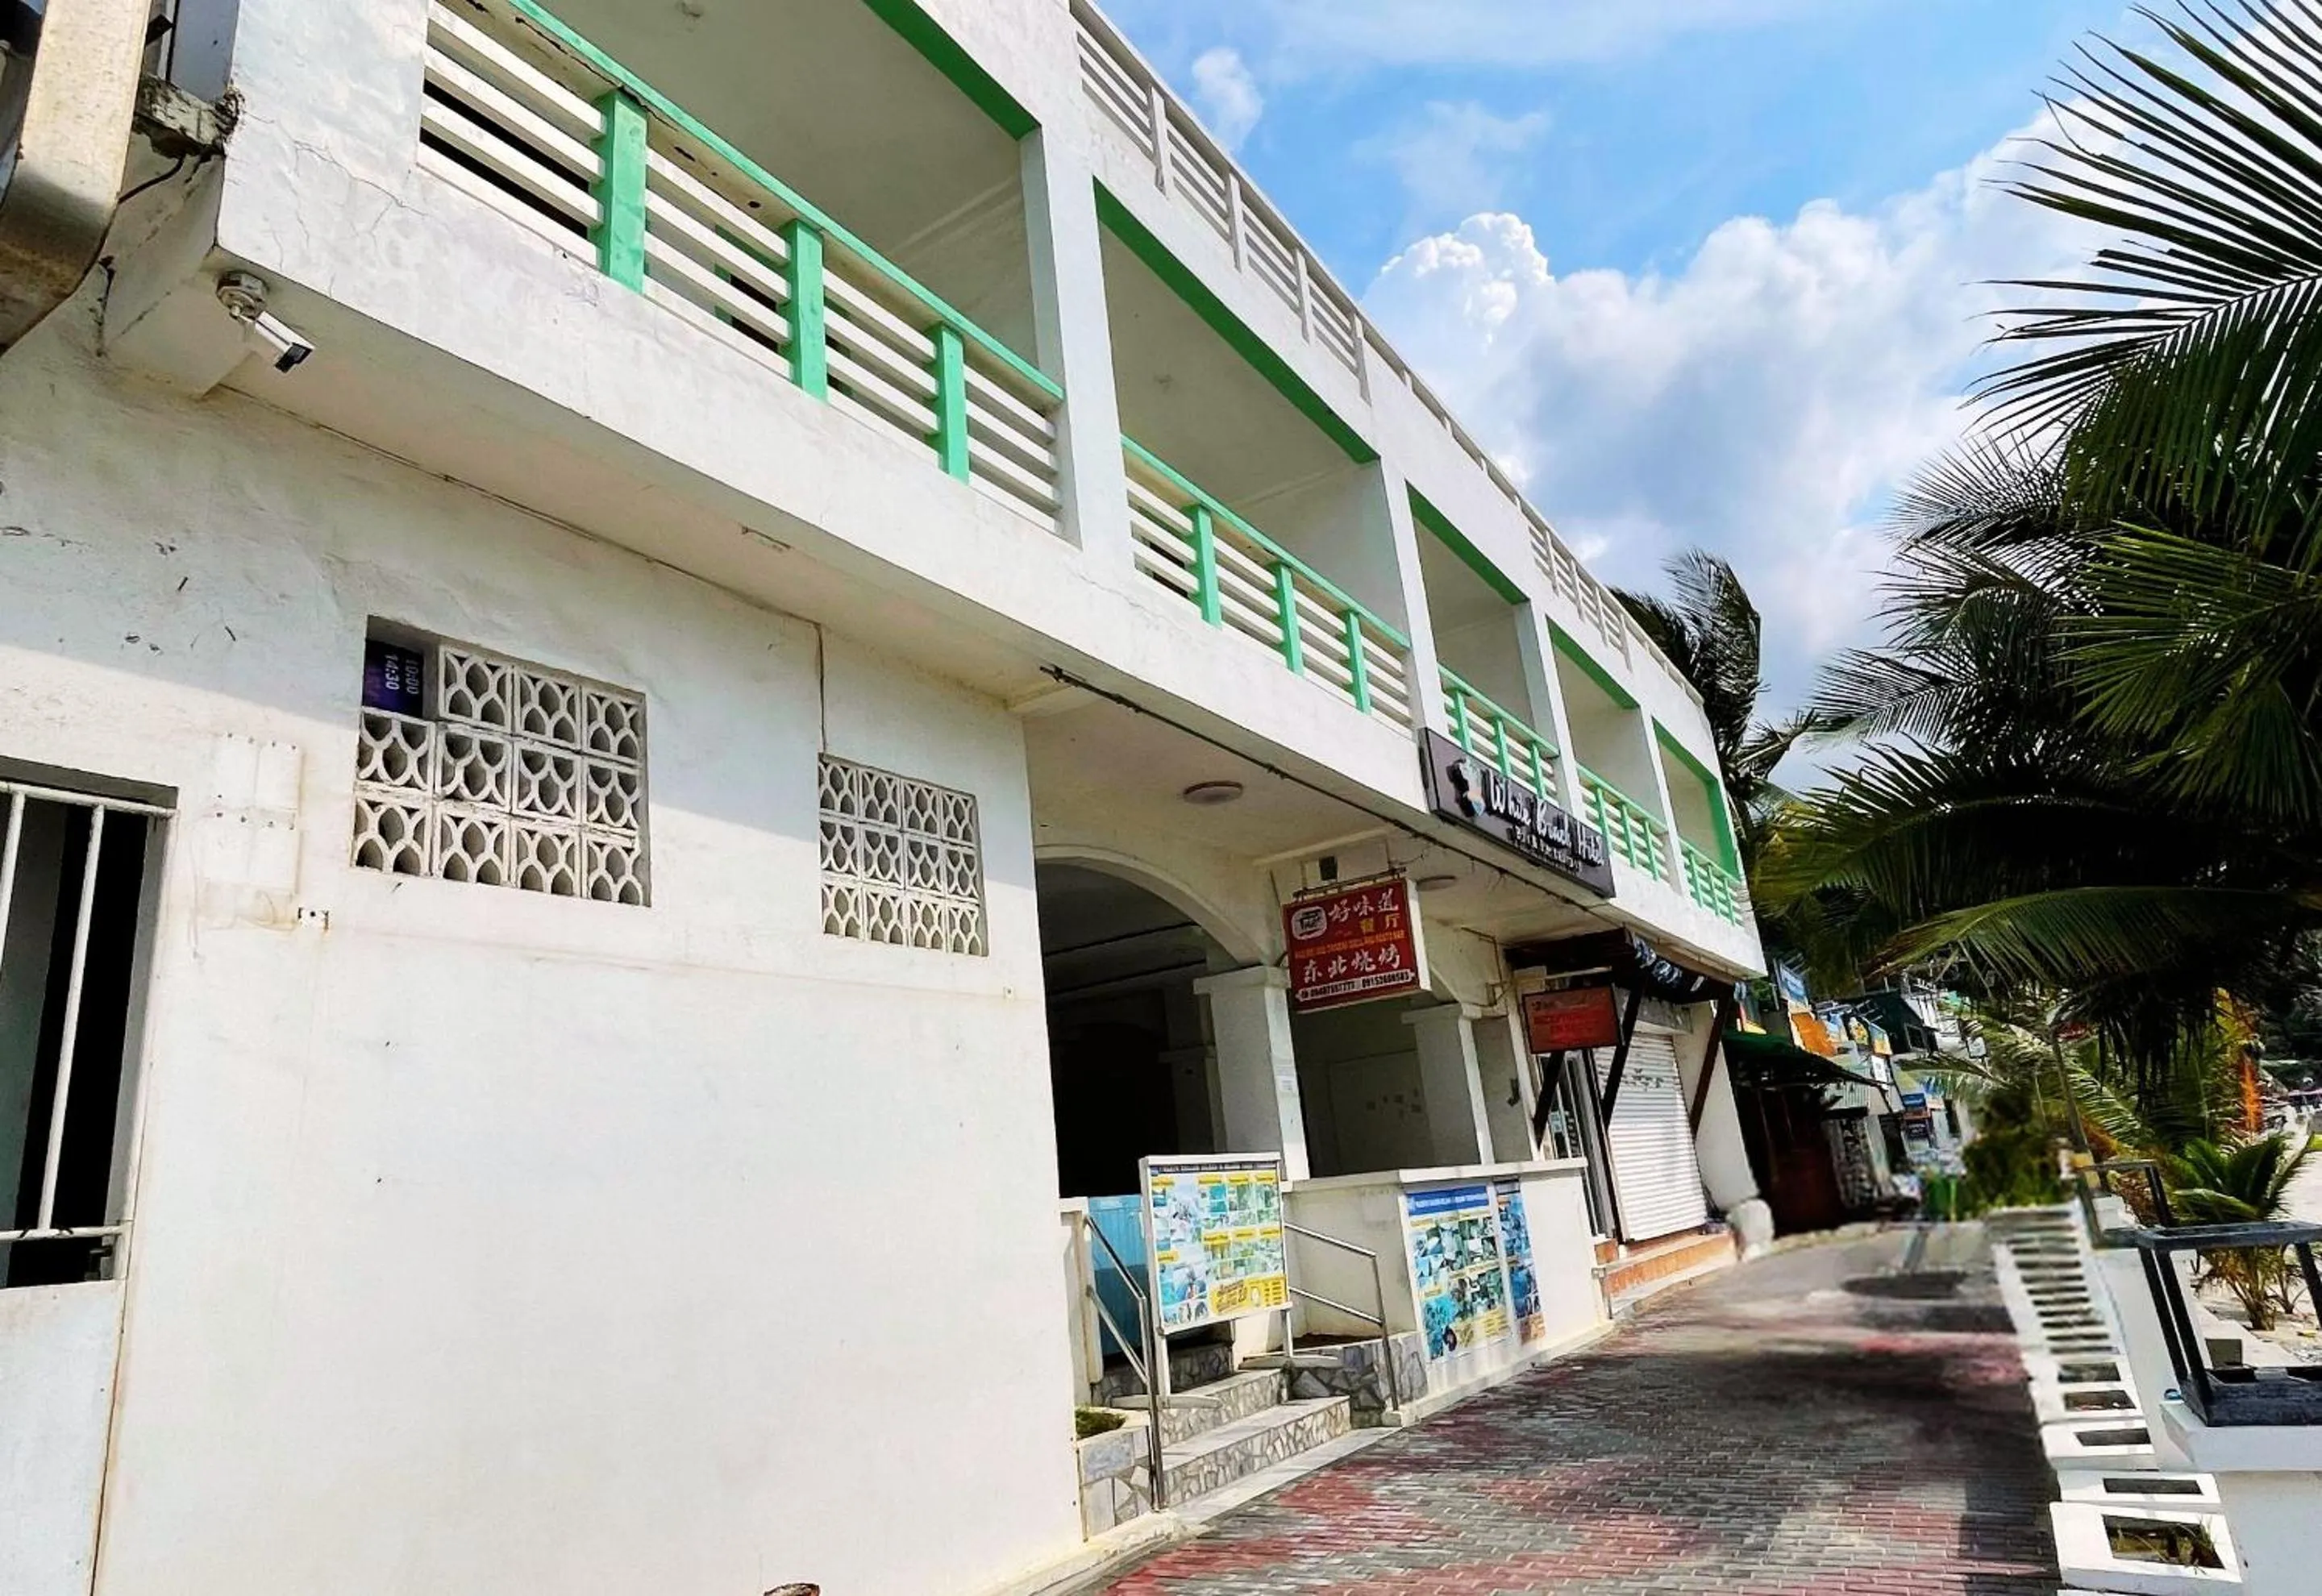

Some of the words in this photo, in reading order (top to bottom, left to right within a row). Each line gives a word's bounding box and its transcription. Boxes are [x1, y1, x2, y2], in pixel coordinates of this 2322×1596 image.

[1328, 887, 1400, 922] 好味道
[1303, 943, 1401, 983] 东北烧烤
